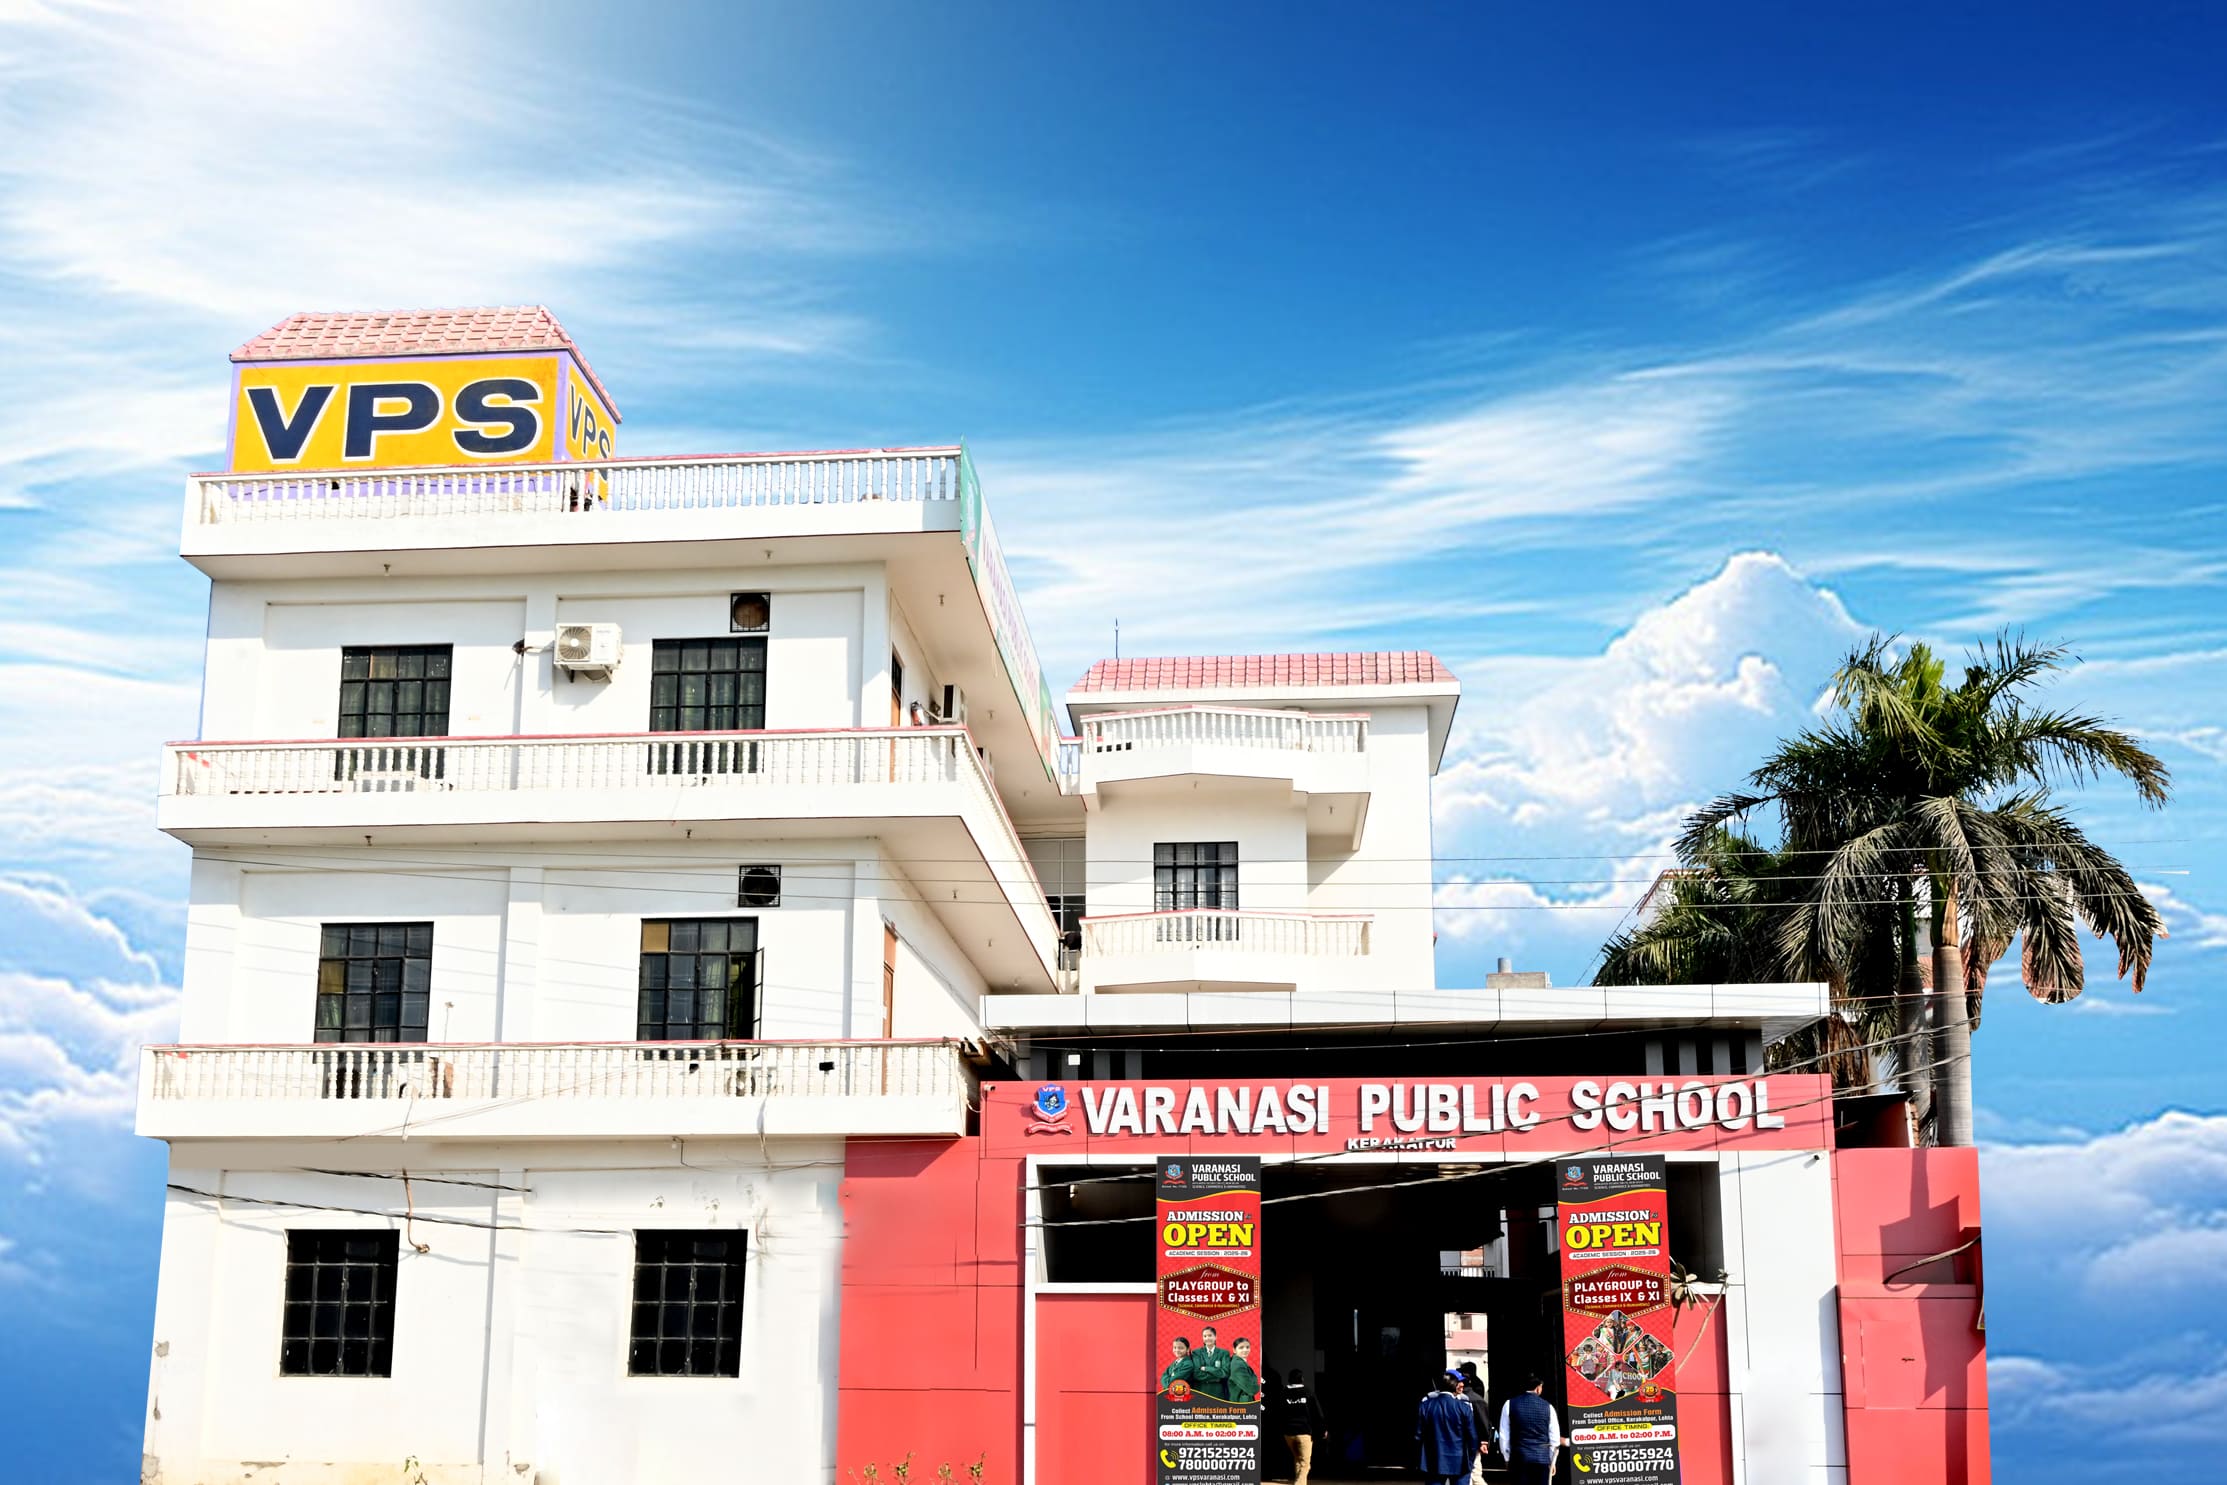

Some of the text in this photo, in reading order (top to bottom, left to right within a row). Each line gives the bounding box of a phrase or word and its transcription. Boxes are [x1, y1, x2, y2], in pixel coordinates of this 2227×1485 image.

[245, 378, 542, 462] VPS
[1081, 1080, 1785, 1135] VARANASI PUBLIC SCHOOL
[1191, 1164, 1240, 1173] VARANASI
[1593, 1163, 1644, 1174] VARANASI
[1191, 1173, 1256, 1182] PUBLIC SCHOOL
[1593, 1173, 1625, 1183] PUBLIC
[1626, 1171, 1661, 1181] SCHOOL
[1167, 1211, 1244, 1222] ADMISSION
[1569, 1210, 1650, 1224] ADMISSION
[1163, 1223, 1254, 1247] OPEN
[1565, 1222, 1660, 1249] OPEN
[1200, 1269, 1220, 1279] from
[1607, 1269, 1628, 1280] from
[1168, 1281, 1249, 1291] PLAYGROUP to
[1574, 1280, 1658, 1293] PLAYGROUP to
[1168, 1293, 1250, 1303] Classes IX & XI
[1574, 1291, 1660, 1304] Classes IX & XI
[1574, 1434, 1596, 1442] 08:00
[1598, 1433, 1619, 1441] A.M.
[1179, 1447, 1255, 1458] 9721525924
[1592, 1447, 1673, 1462] 9721525924
[1178, 1459, 1256, 1470] 7800007770
[1592, 1459, 1674, 1474] 7800007770
[1586, 1475, 1659, 1484] www.vpsvaranasi.com
